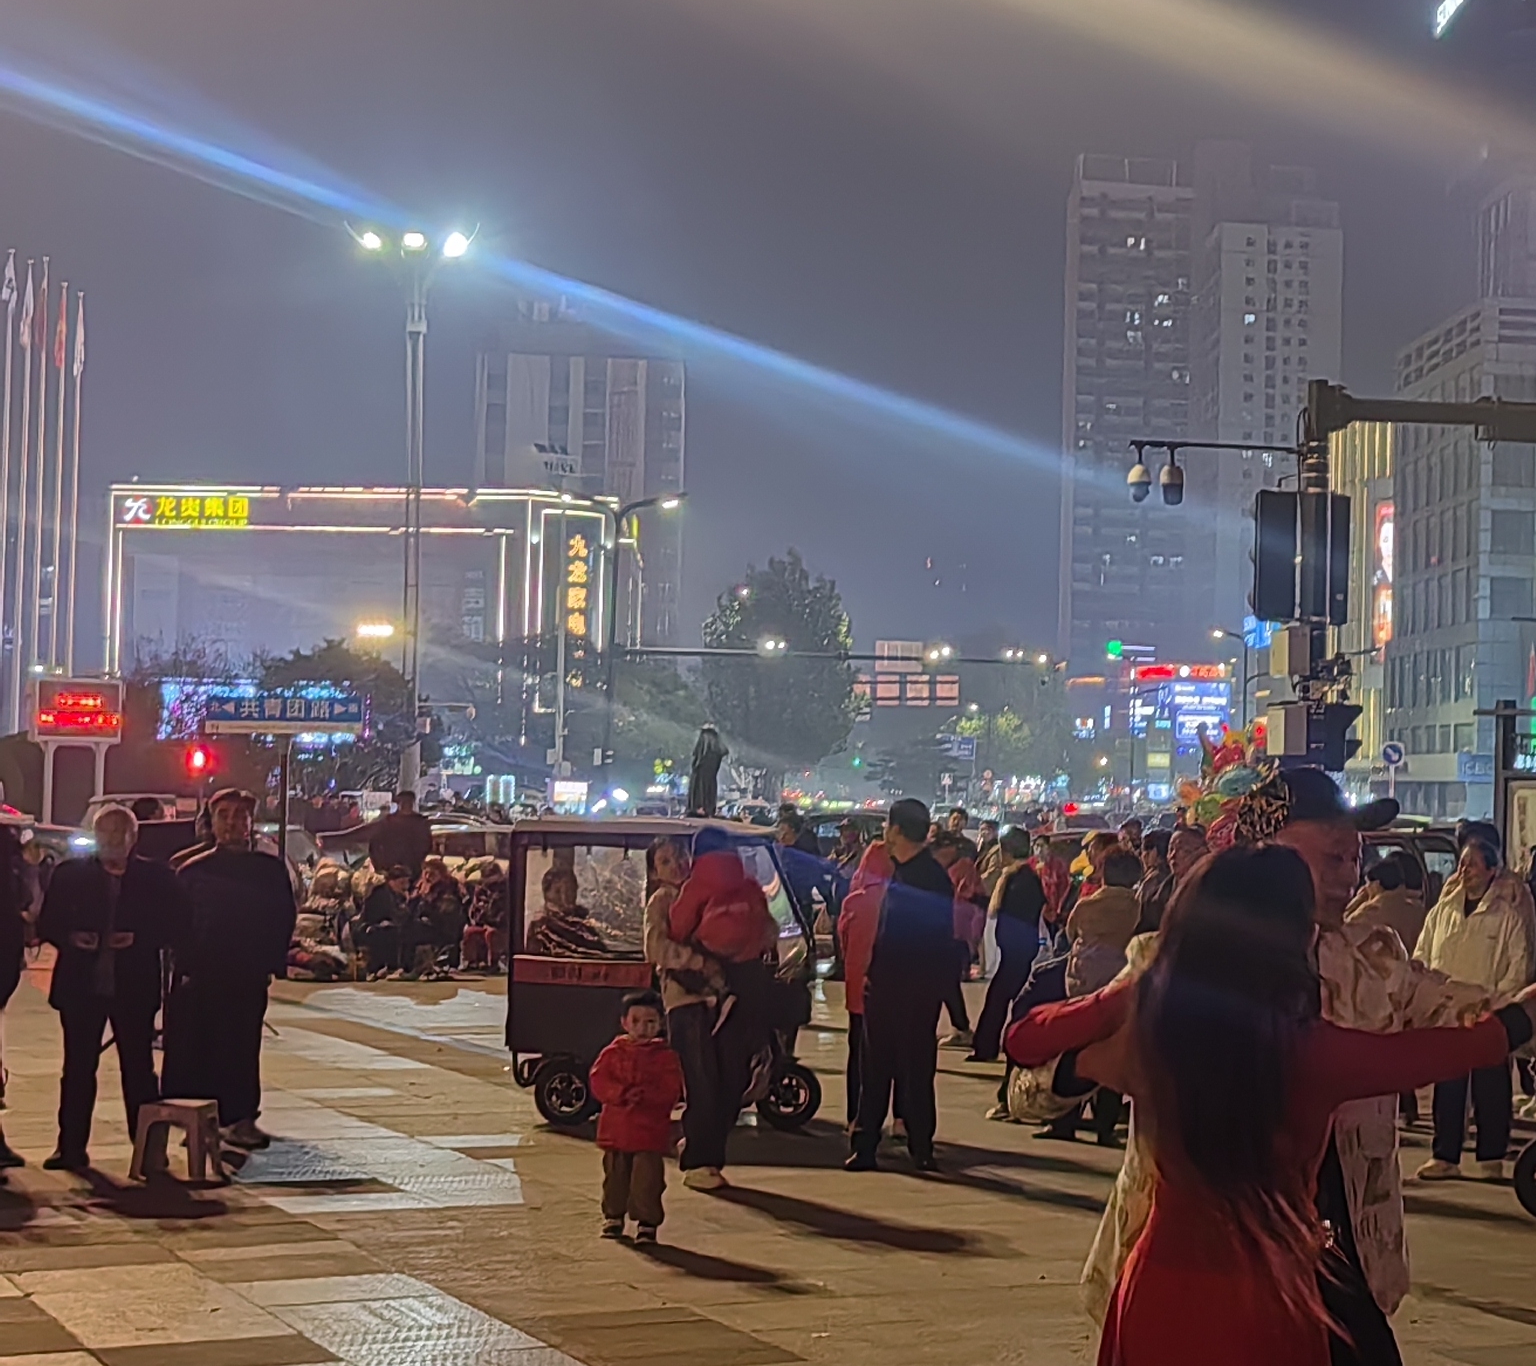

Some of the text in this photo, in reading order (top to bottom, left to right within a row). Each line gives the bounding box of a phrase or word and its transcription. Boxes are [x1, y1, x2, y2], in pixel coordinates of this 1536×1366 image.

[155, 496, 249, 518] 龙贵集团
[239, 698, 331, 719] 共青团路
